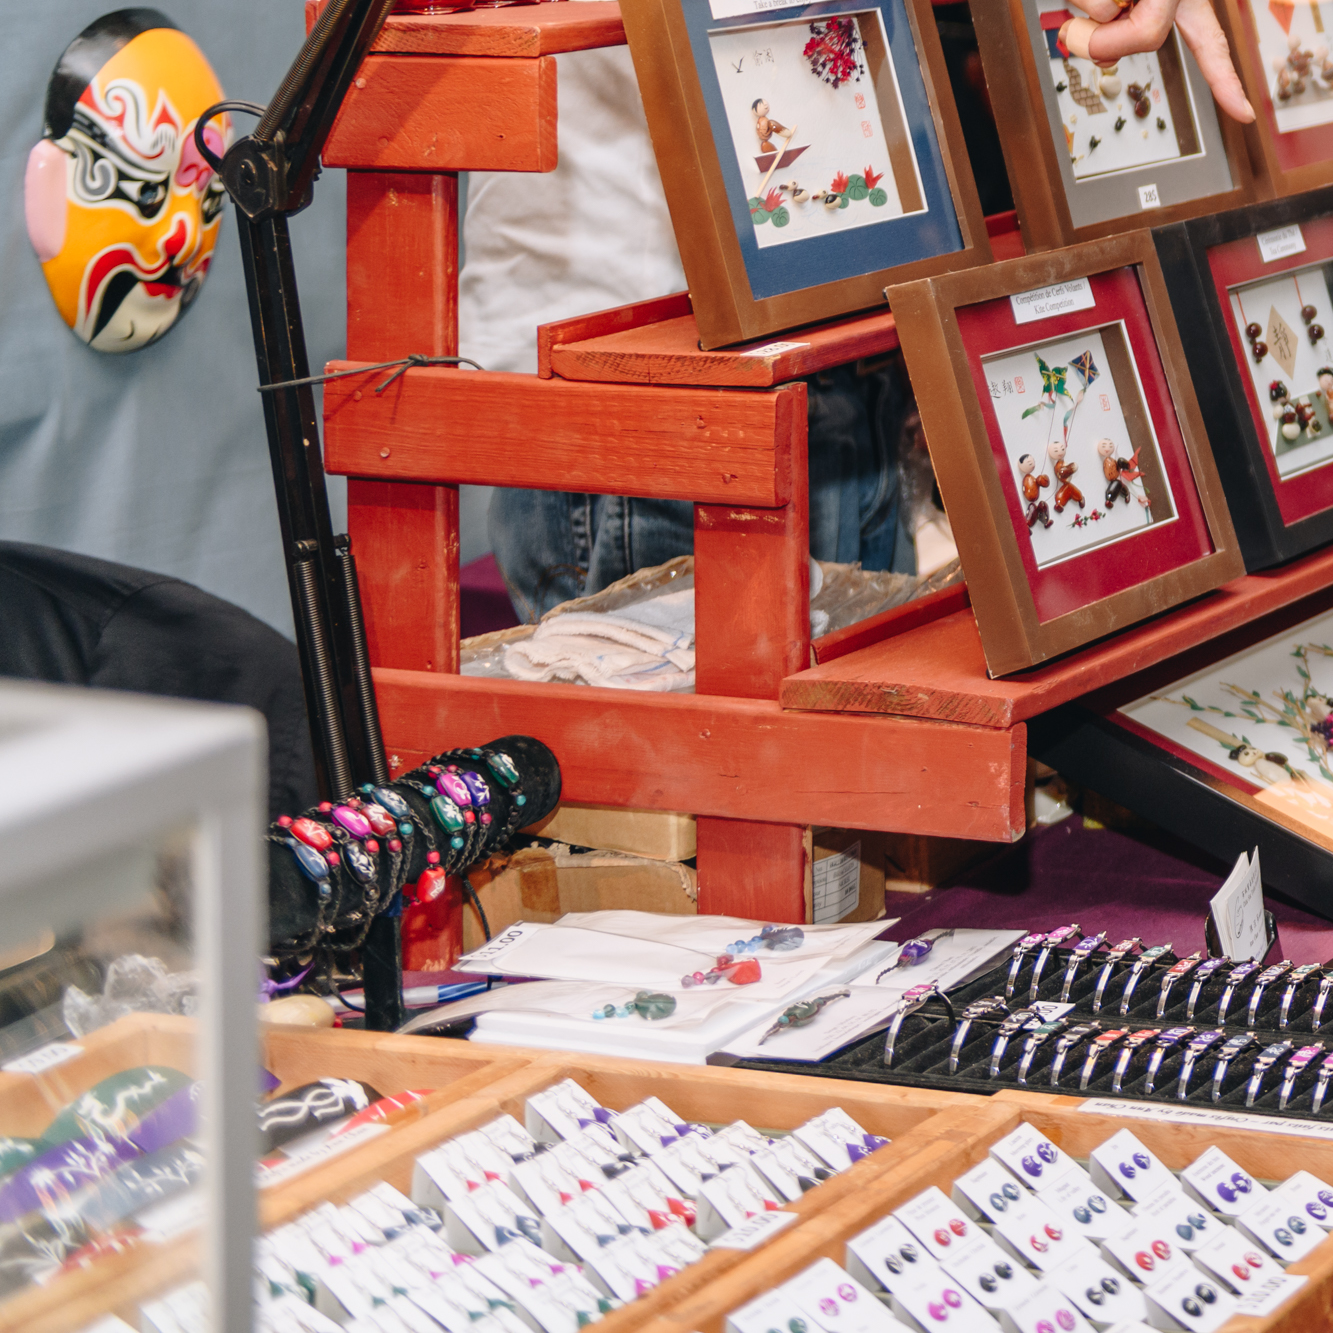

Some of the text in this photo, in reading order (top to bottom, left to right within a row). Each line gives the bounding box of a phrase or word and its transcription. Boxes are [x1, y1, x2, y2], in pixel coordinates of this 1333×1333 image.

[753, 0, 767, 10] Take
[1015, 291, 1045, 305] Compétition
[1045, 288, 1052, 298] de
[1052, 286, 1065, 297] Cerfs
[1066, 282, 1083, 293] Volants
[1034, 298, 1074, 315] Kite Competition
[470, 930, 523, 957] $11.00
[1093, 1099, 1127, 1111] Chan
[1156, 1105, 1172, 1116] by
[1174, 1109, 1207, 1119] made
[1261, 1117, 1285, 1128] par
